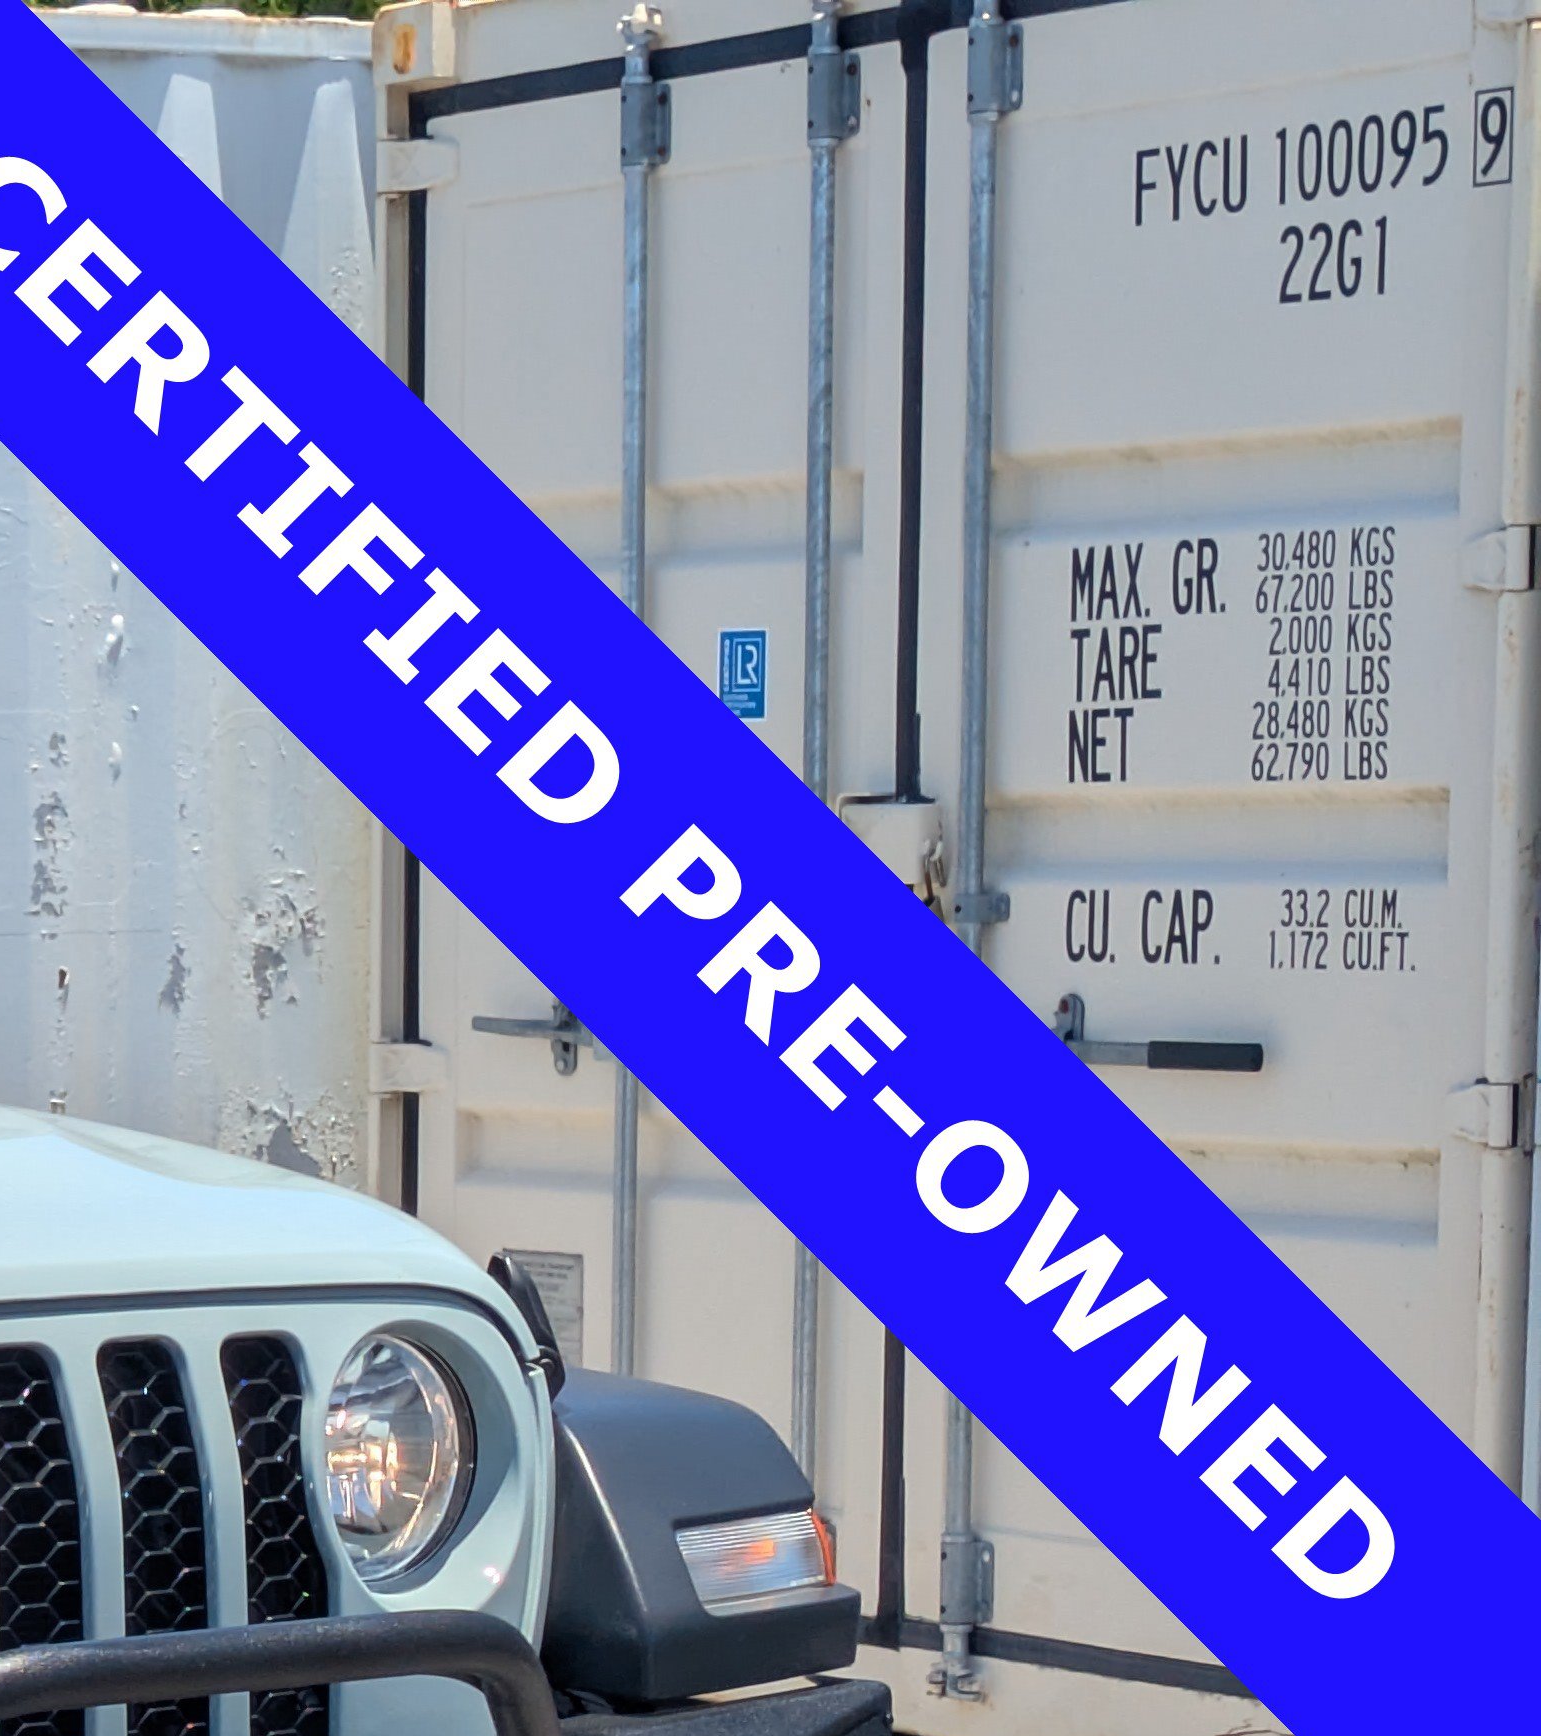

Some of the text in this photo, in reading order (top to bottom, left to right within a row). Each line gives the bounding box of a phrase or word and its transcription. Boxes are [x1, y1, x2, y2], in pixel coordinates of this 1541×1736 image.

[1134, 95, 1508, 227] FYCU 100095 9
[1279, 215, 1388, 304] 22G1
[1349, 525, 1396, 567] KGS
[1070, 537, 1226, 623] MAX. GR.
[1348, 569, 1394, 611] LBS
[1346, 611, 1392, 653] KGS
[1070, 623, 1163, 703] TARE
[1345, 655, 1391, 696] LBS
[1344, 697, 1390, 738] KGS
[1068, 707, 1135, 783] NET
[1343, 740, 1389, 781] LBS
[1065, 888, 1221, 965] CU. CAP.
[1280, 888, 1402, 929] 33.2 CU.M.
[1342, 931, 1416, 972] CU.FT.
